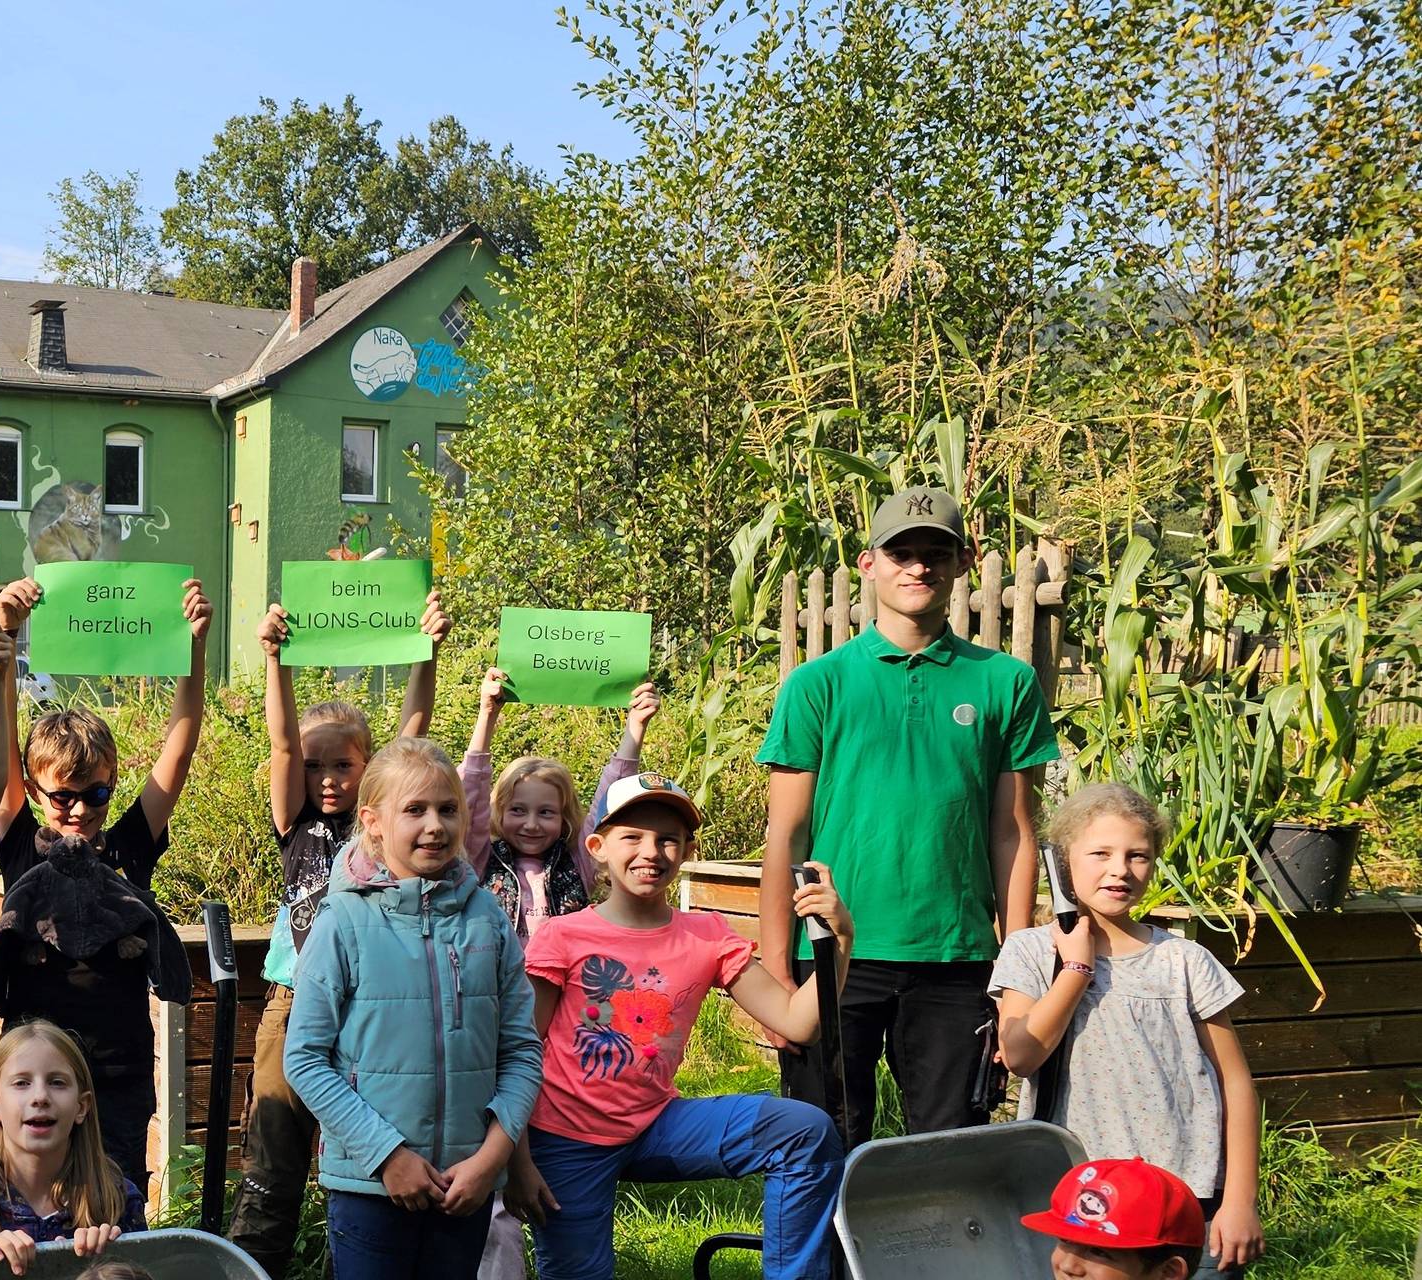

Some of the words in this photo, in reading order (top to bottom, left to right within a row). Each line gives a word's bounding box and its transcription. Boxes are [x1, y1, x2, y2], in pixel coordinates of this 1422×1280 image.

[373, 328, 403, 346] NaRa
[86, 584, 137, 604] ganz
[331, 579, 382, 597] beim
[68, 613, 153, 635] herzlich
[296, 611, 417, 630] LIONS-Club
[526, 624, 606, 646] Olsberg
[532, 652, 612, 676] Bestwig
